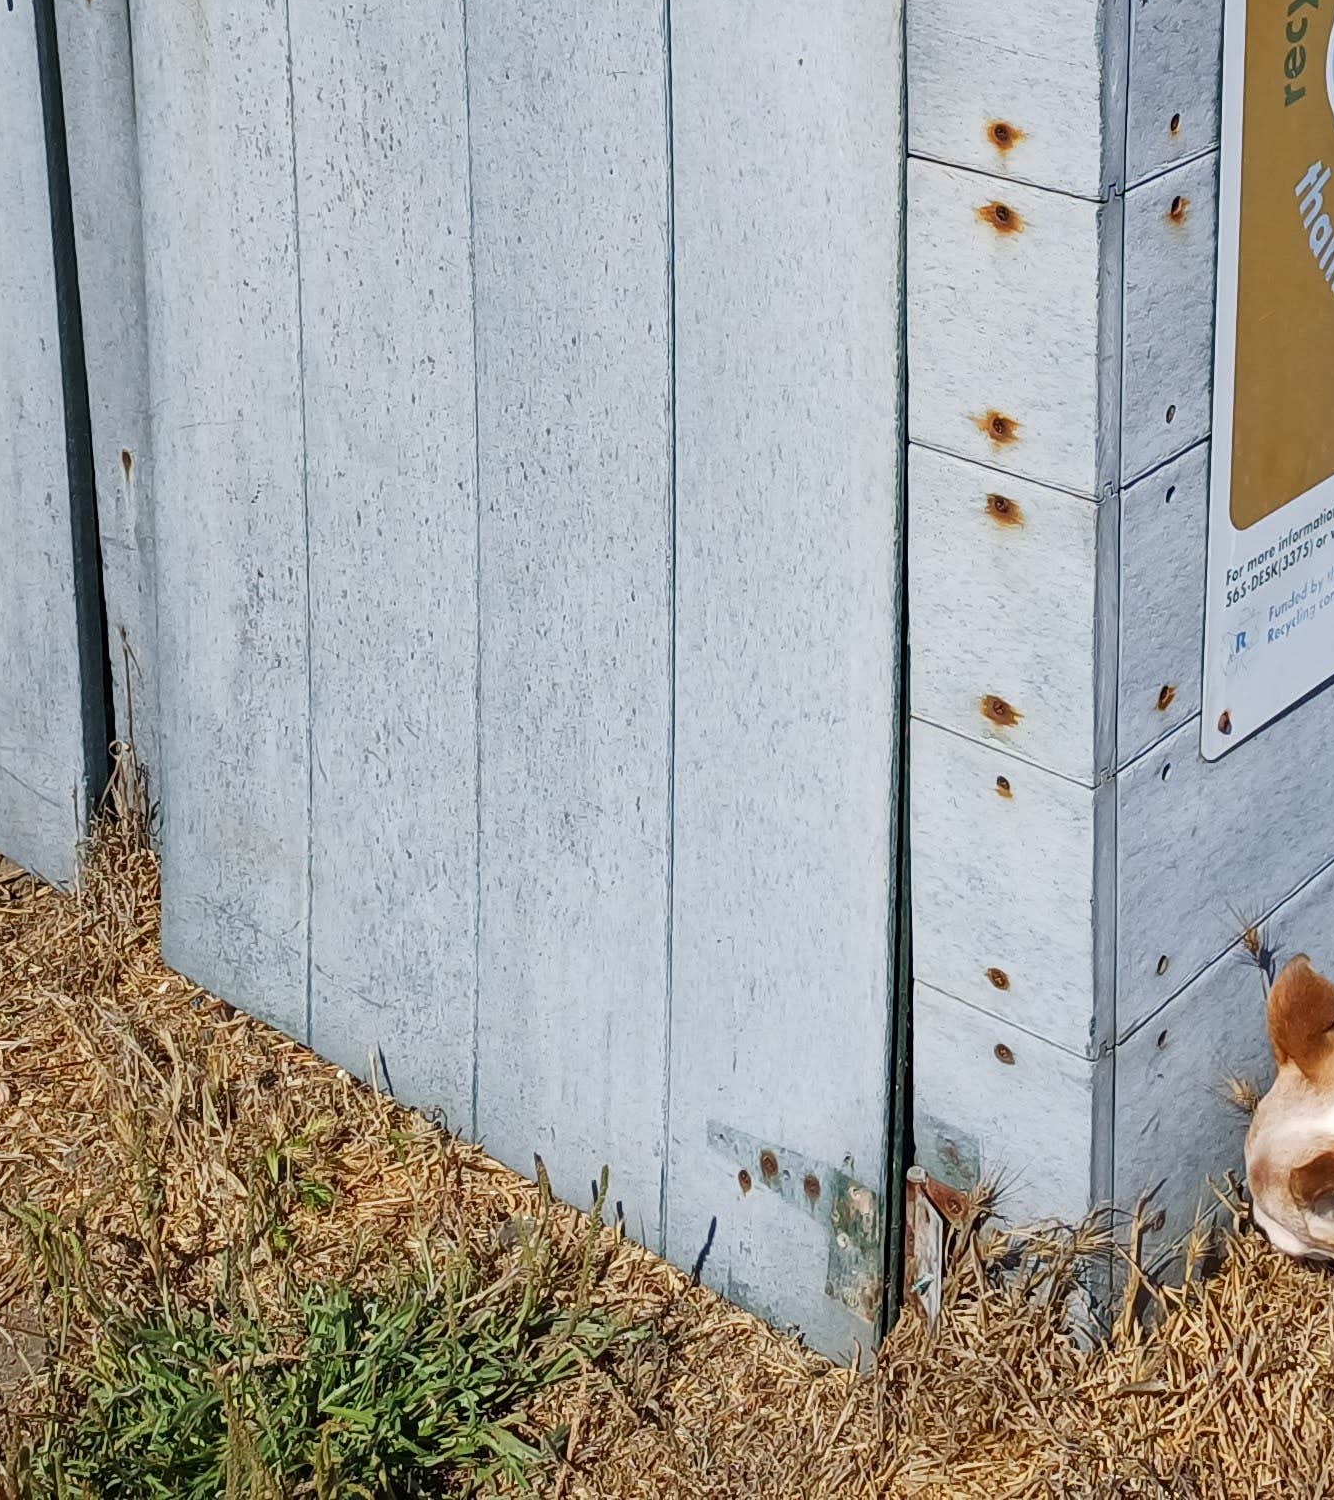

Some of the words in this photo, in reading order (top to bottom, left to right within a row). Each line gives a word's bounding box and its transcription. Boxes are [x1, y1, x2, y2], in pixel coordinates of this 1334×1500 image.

[1316, 533, 1328, 549] or
[1226, 565, 1244, 586] For
[1247, 546, 1275, 572] more
[1269, 581, 1307, 622] Funded
[1310, 578, 1324, 594] by
[1267, 604, 1316, 644] Recycling
